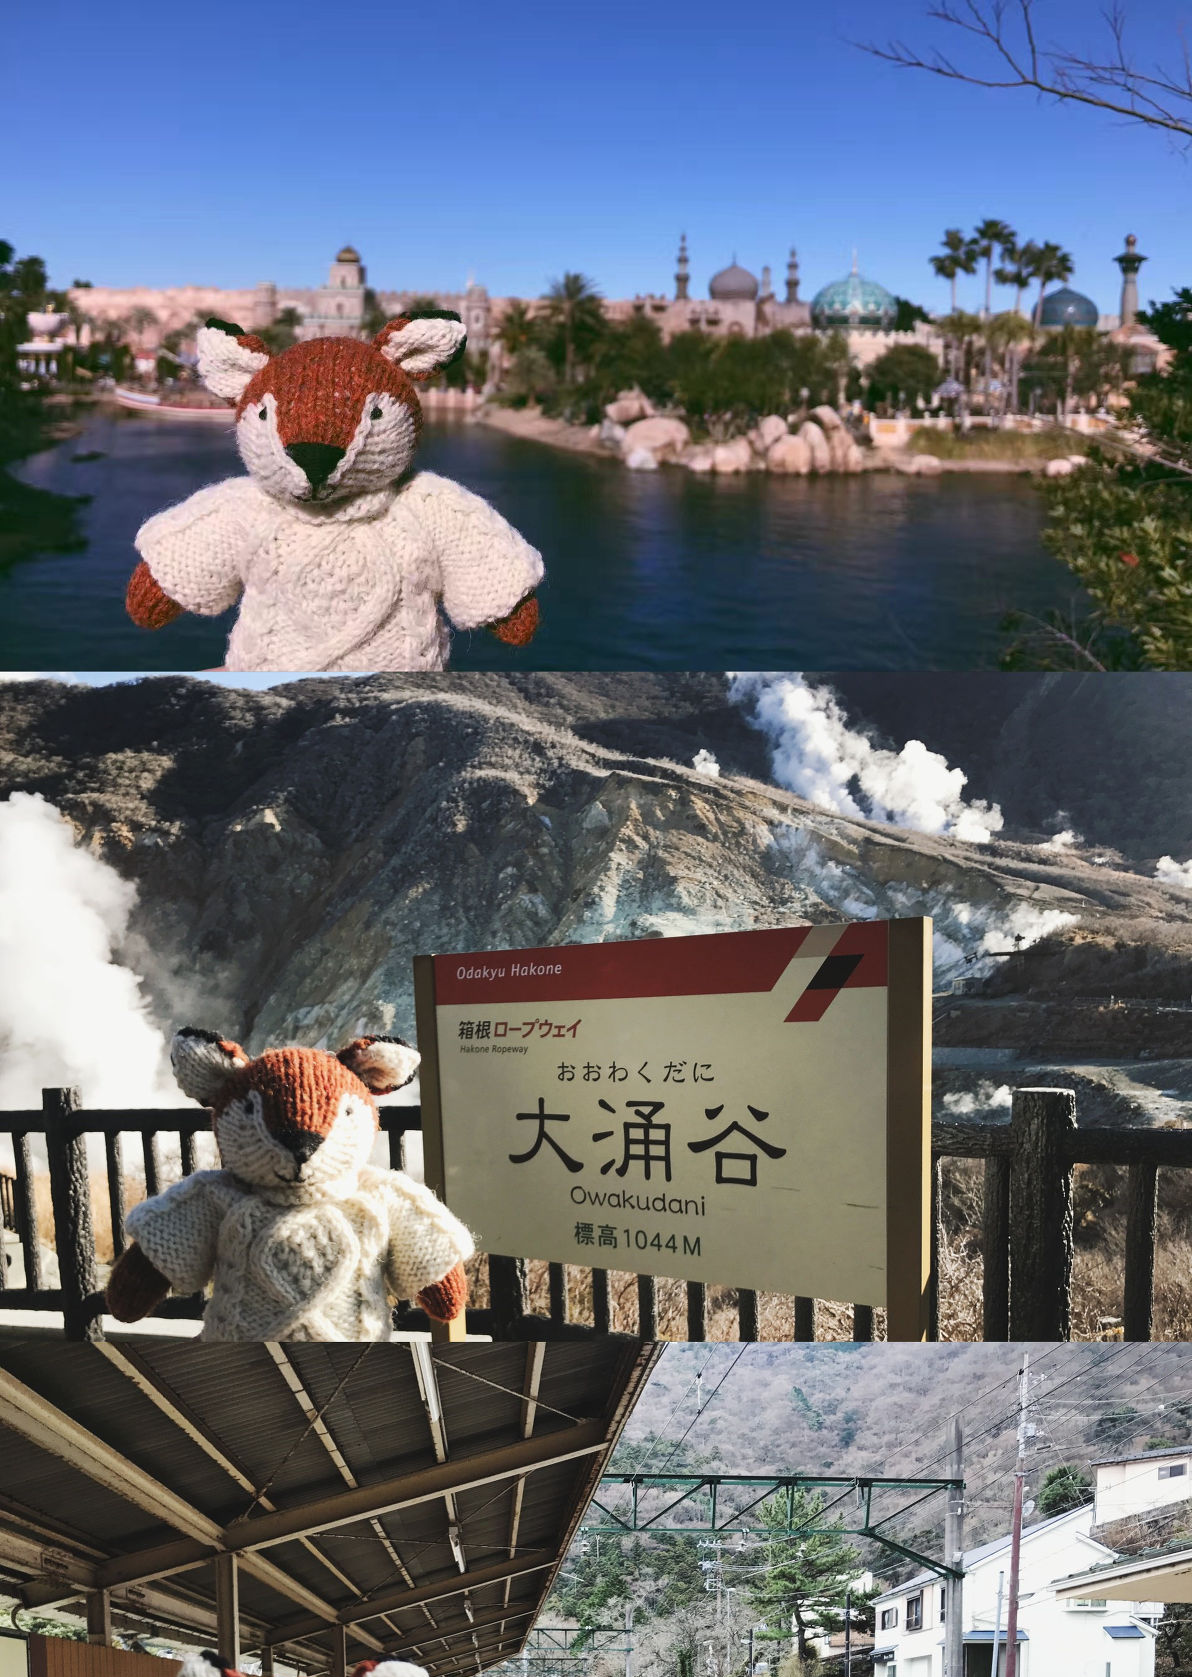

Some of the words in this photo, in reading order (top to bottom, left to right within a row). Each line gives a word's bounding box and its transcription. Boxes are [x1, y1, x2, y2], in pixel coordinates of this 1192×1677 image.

[456, 966, 506, 981] Odakyu
[511, 962, 562, 977] Hakone
[458, 1018, 582, 1040] 箱根ロープウェイ
[460, 1045, 490, 1054] Hakone
[492, 1045, 529, 1055] Ropeway
[557, 1060, 716, 1083] おおわくだに
[508, 1096, 787, 1187] 大涌谷
[570, 1185, 706, 1217] Owakudani
